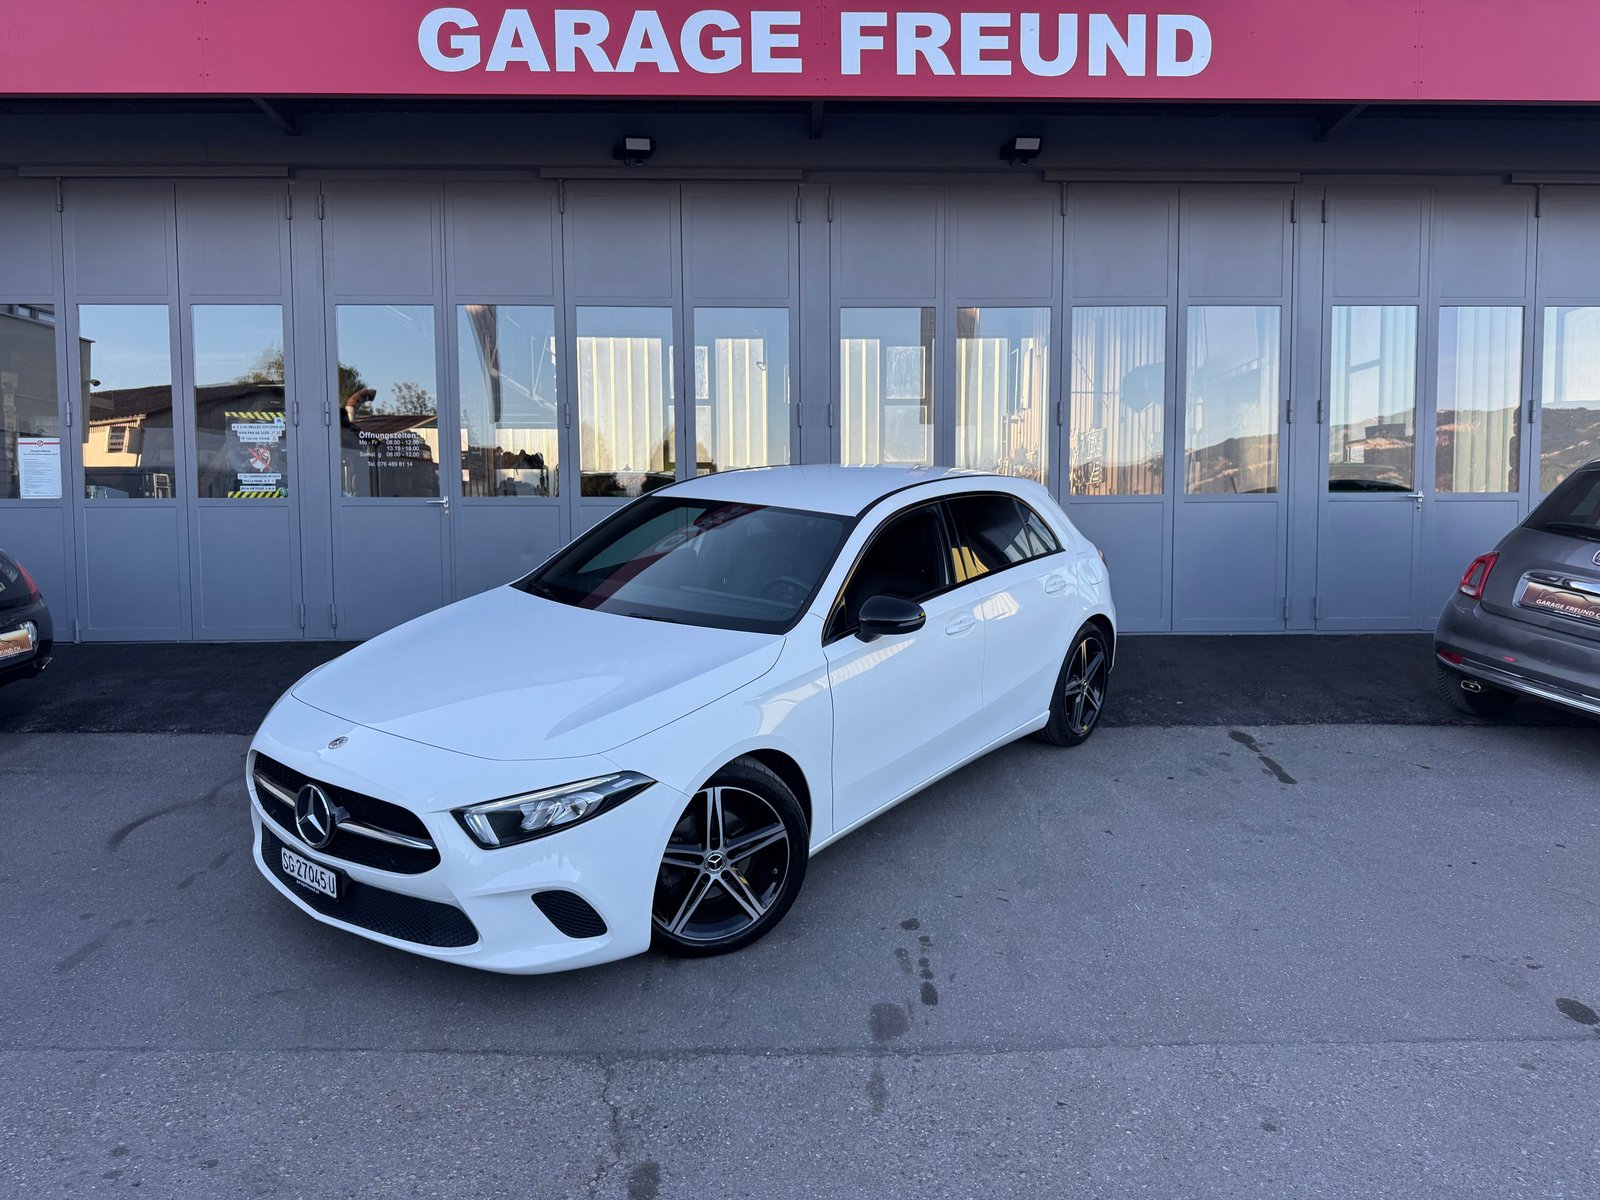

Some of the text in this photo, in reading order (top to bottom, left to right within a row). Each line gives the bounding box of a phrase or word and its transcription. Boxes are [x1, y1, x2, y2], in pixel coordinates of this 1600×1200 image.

[417, 7, 1212, 77] GARAGE FREUND
[359, 431, 419, 440] Öffnungszeiten:
[1535, 598, 1564, 610] GARAGE
